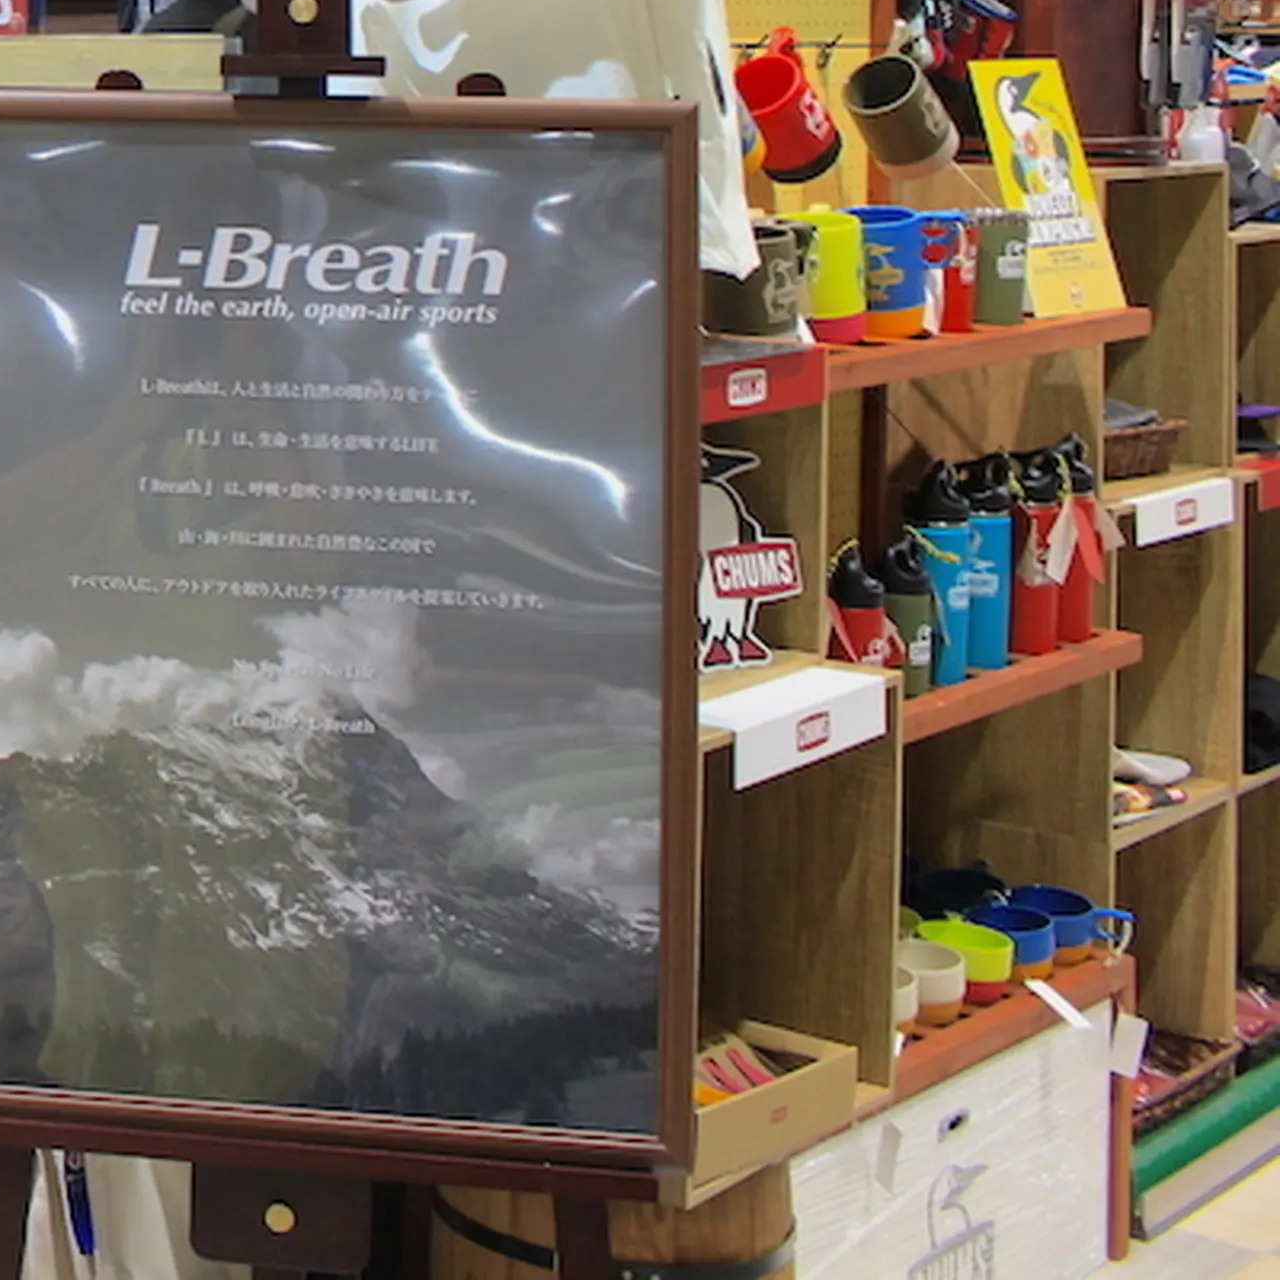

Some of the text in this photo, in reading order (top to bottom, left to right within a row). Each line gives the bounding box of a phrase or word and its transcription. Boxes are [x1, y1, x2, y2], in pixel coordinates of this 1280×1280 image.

[124, 222, 508, 296] L-Breath
[120, 291, 499, 329] feel the earth, open-air sports
[714, 549, 794, 592] CHUMS
